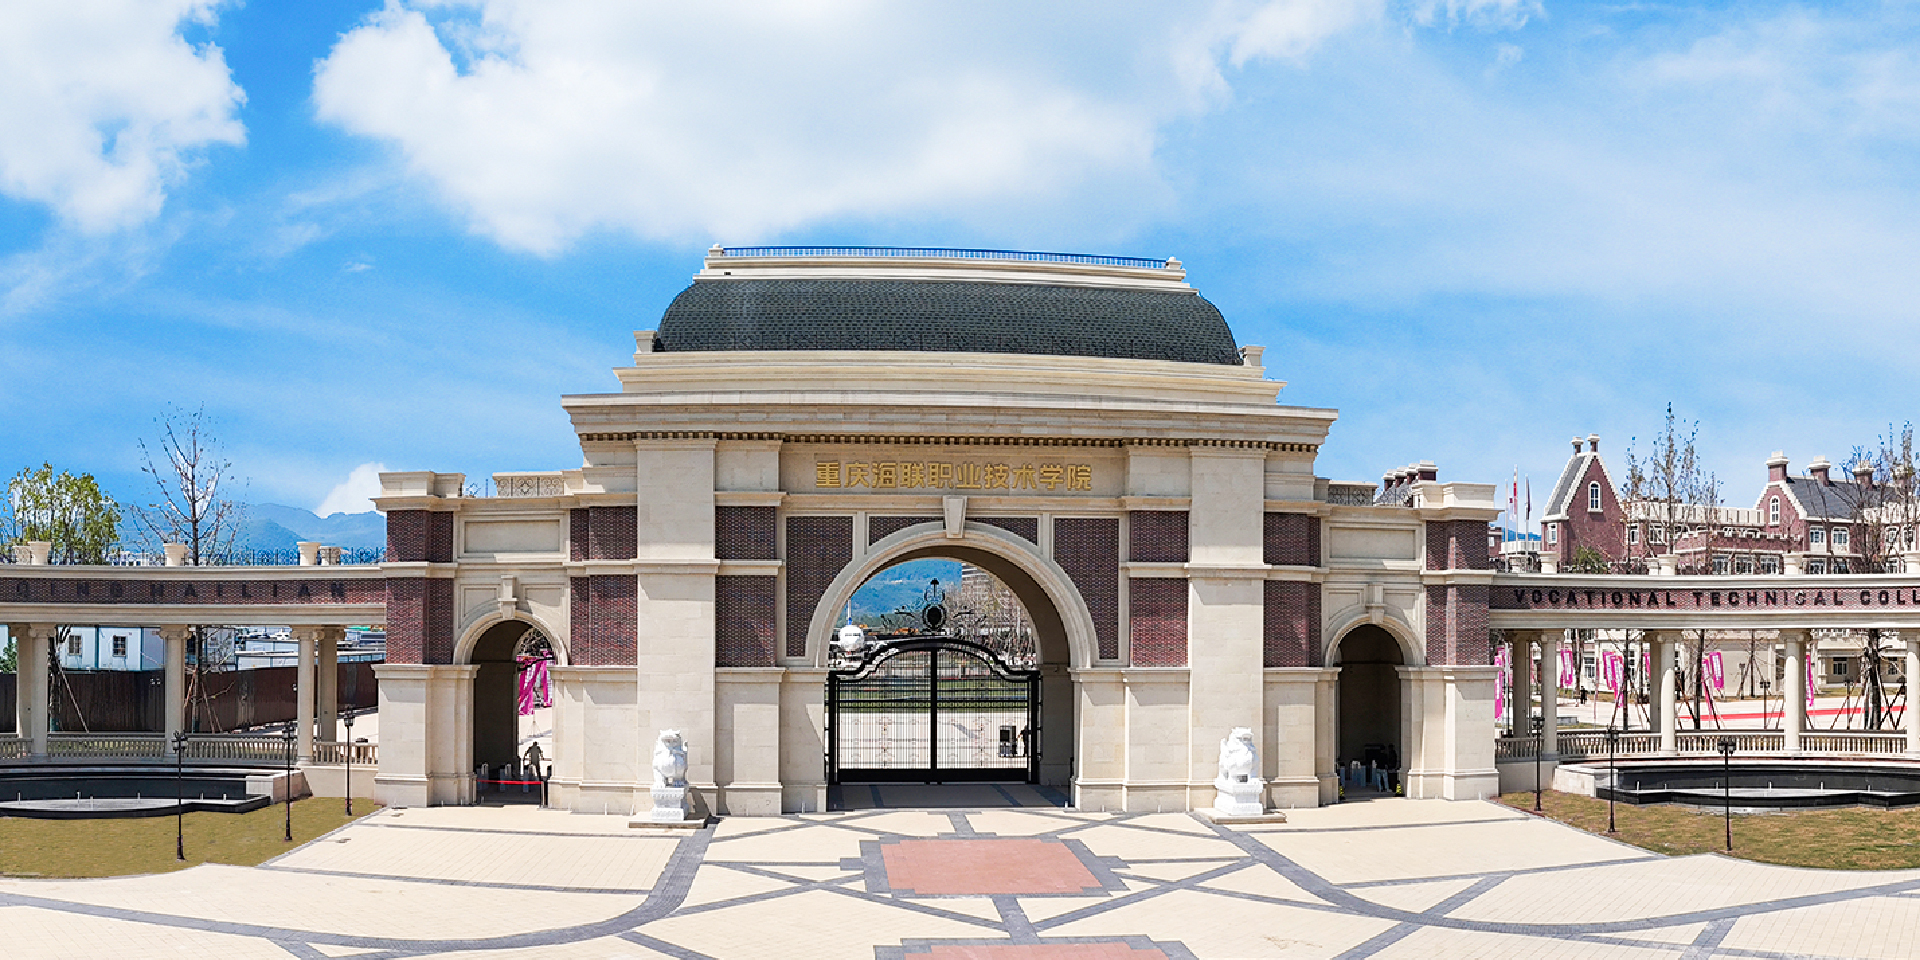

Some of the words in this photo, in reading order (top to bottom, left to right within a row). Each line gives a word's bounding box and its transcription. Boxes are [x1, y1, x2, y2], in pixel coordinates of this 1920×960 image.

[815, 460, 1092, 490] 重庆海联职业技术学院
[1513, 589, 1675, 606] VOCATIONAL
[1693, 590, 1843, 606] TECHNICAL
[1860, 589, 1920, 605] COLL
